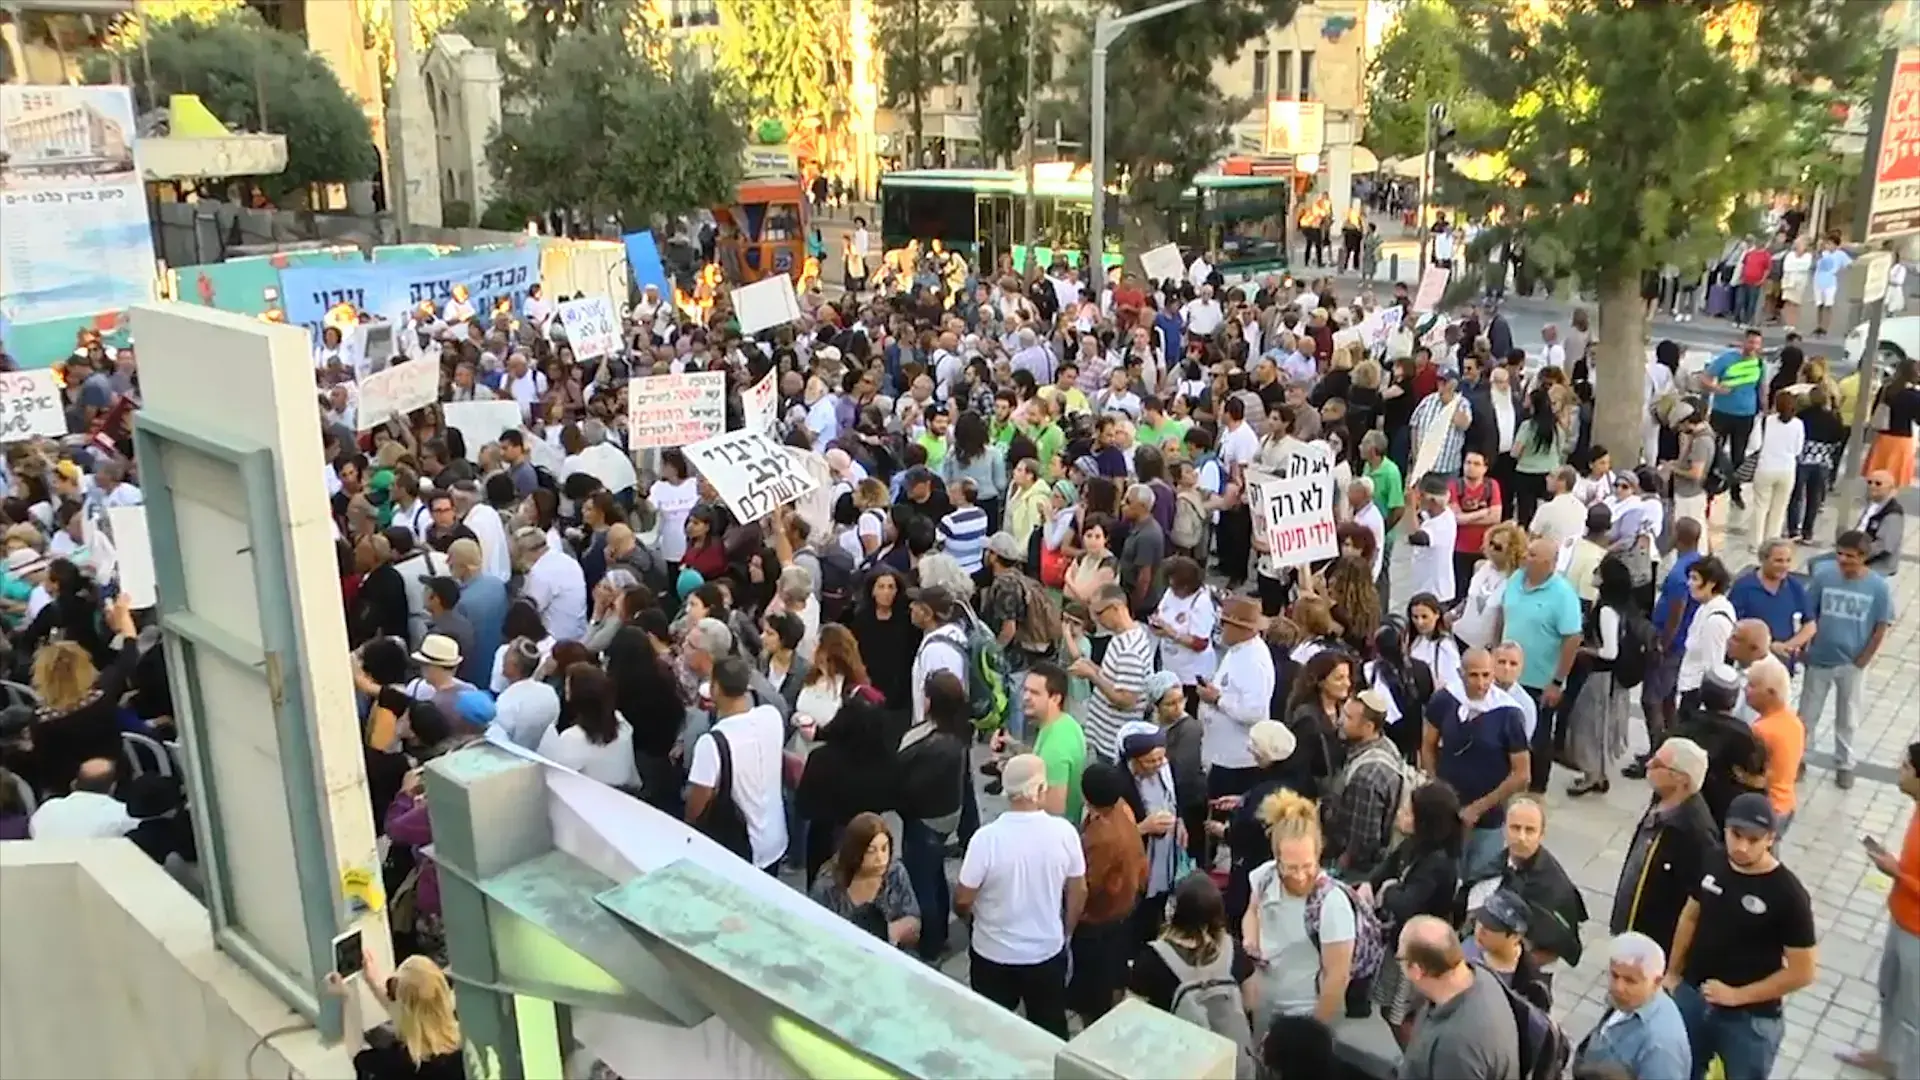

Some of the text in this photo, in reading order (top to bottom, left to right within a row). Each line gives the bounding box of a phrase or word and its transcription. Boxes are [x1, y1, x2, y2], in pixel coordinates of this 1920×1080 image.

[737, 474, 812, 520] משולם
[1270, 494, 1295, 525] רק
[1300, 482, 1324, 514] לא
[1270, 519, 1335, 559] ילדי תימן!
